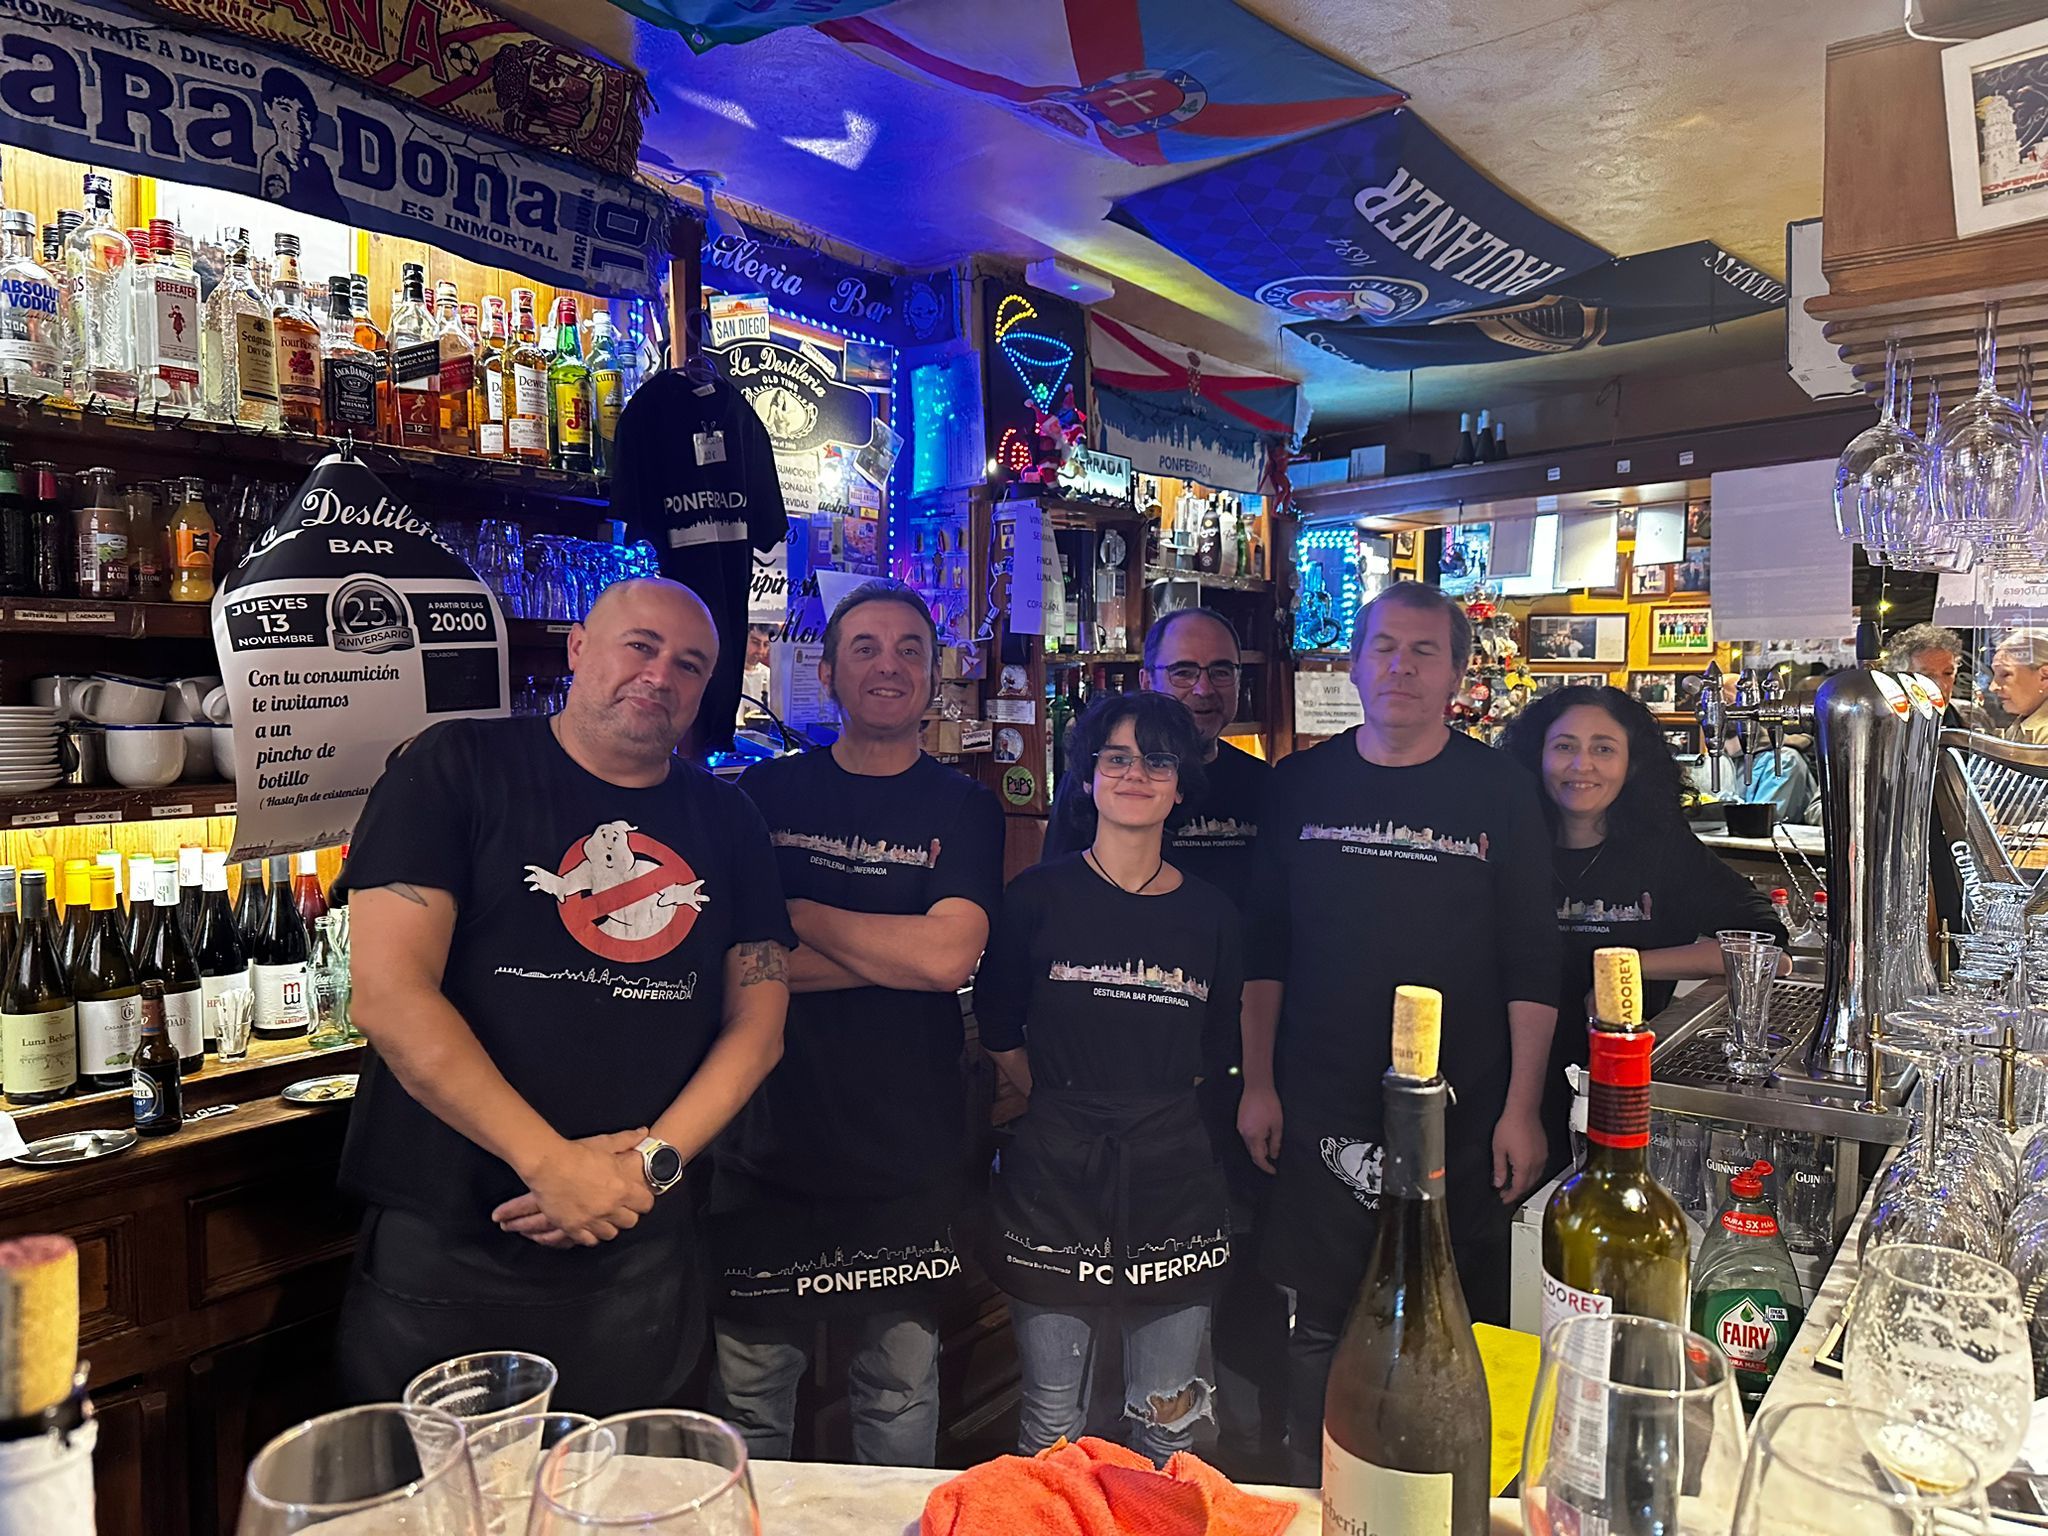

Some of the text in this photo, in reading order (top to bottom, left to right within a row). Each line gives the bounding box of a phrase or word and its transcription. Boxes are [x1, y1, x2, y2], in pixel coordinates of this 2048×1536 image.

[158, 38, 175, 59] A
[178, 45, 257, 79] DIEGO
[401, 199, 559, 262] ES INMORTAL
[1353, 166, 1566, 296] PAULANER
[1, 278, 60, 303] ABSOLUT
[155, 280, 198, 299] BEEFEATER
[8, 293, 58, 316] VODKA
[829, 276, 893, 324] Bar
[716, 316, 767, 339] SAN DIEGO
[280, 336, 300, 348] Four
[333, 365, 351, 379] JACK
[349, 365, 376, 384] DANIEL'S
[730, 347, 760, 377] La
[759, 347, 826, 398] Destileria
[761, 375, 779, 384] OLD
[413, 424, 424, 433] 12
[1159, 454, 1212, 480] PONFERRADA
[328, 539, 394, 555] BAR
[231, 597, 308, 617] JUEVES
[346, 597, 385, 627] 25
[257, 614, 290, 633] 13
[429, 612, 487, 632] 20:00
[238, 634, 315, 647] NOVIEMBRE
[337, 629, 410, 648] ANIVERSARIO
[248, 664, 400, 688] Con tu consumición
[1323, 686, 1340, 694] WIFI
[251, 693, 350, 713] te invitamos
[254, 722, 292, 739] a un
[255, 742, 336, 770] pincho de
[257, 769, 311, 791] botillo
[266, 794, 296, 808] Hasta
[292, 792, 309, 808] fin
[309, 790, 321, 802] de
[322, 787, 369, 801] existencias
[810, 855, 846, 871] DESTILERIA
[1341, 845, 1438, 862] DESTILERIA BAR PONFERRADA
[612, 986, 692, 1000] PONFERRADA
[1093, 987, 1190, 1008] DESTILERIA BAR PONFERRADA
[22, 1037, 46, 1048] Luna
[1723, 1215, 1743, 1227] DURA
[1745, 1219, 1759, 1230] 5X
[796, 1255, 962, 1297] PONFERRADA
[1722, 1320, 1771, 1351] FAIRY
